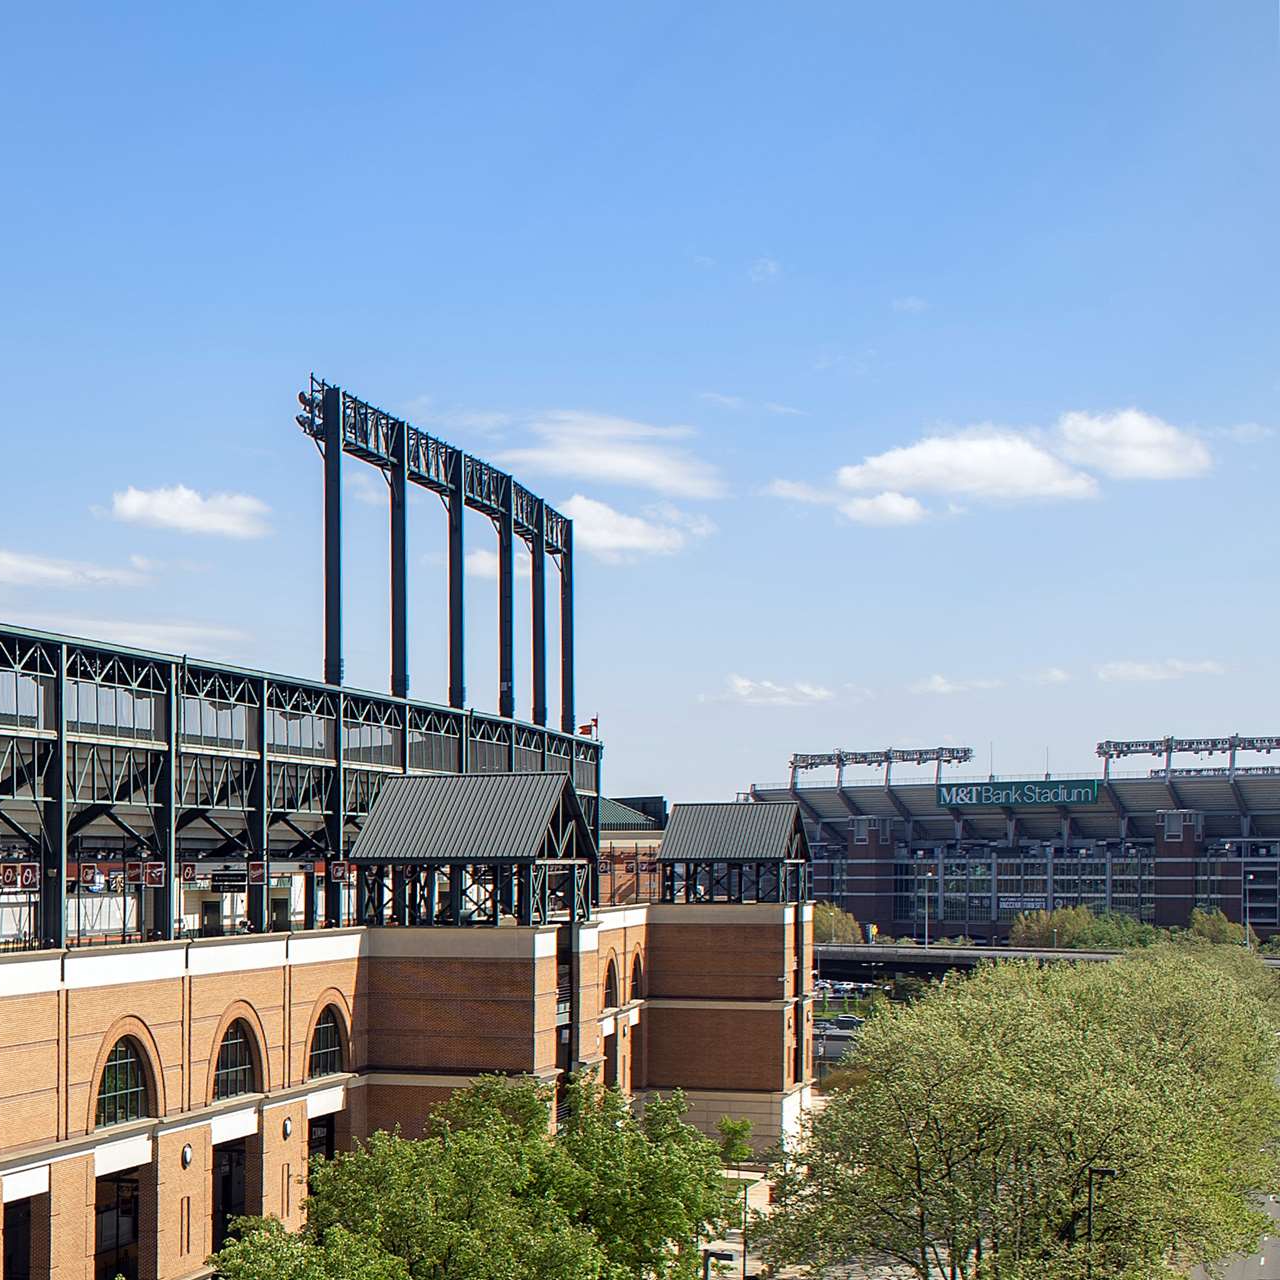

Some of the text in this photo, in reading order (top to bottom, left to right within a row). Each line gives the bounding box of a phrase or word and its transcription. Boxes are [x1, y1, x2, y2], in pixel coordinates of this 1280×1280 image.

[940, 784, 1091, 804] M&T Bank Stadium
